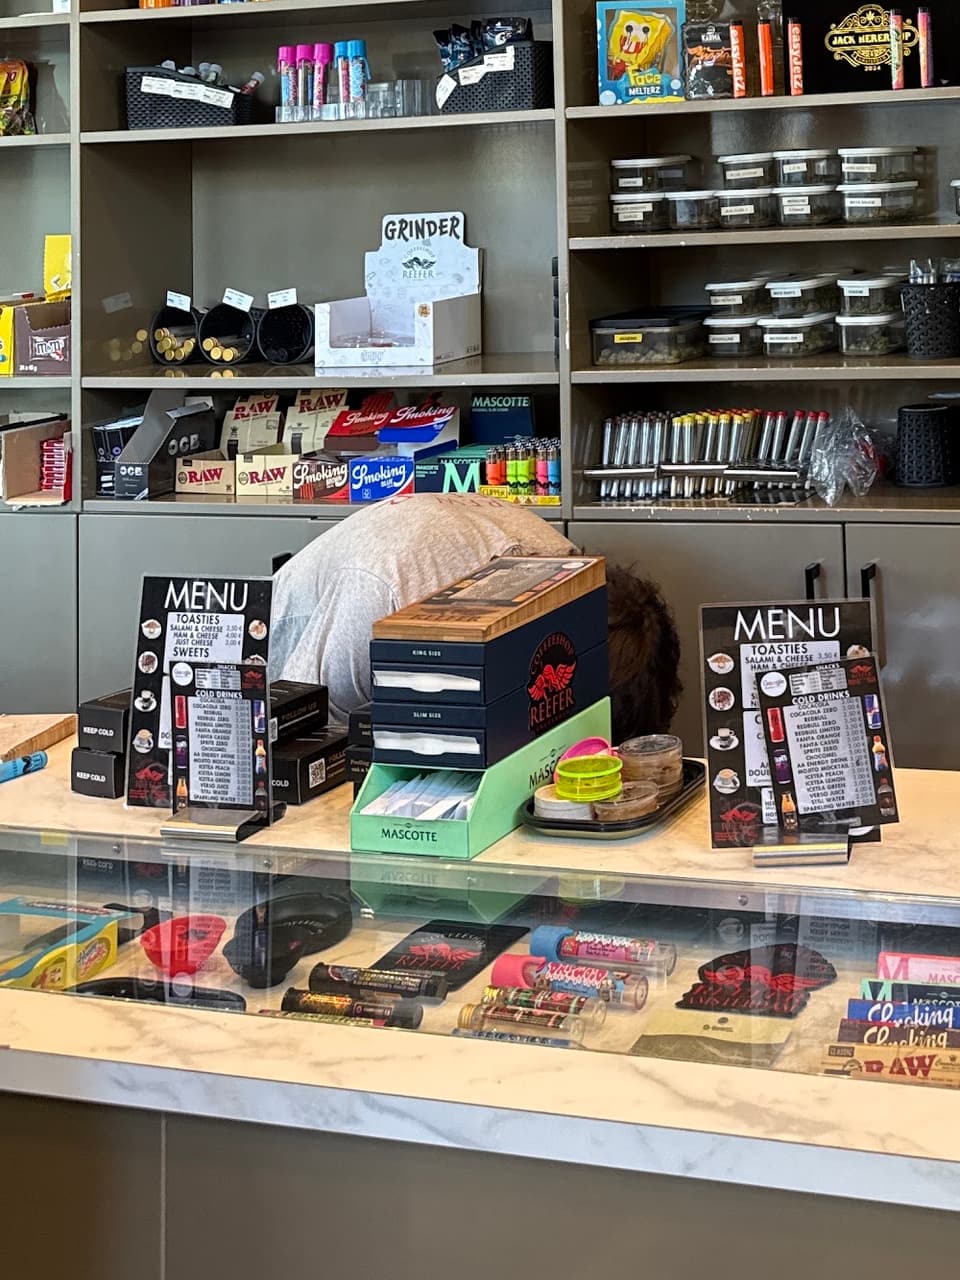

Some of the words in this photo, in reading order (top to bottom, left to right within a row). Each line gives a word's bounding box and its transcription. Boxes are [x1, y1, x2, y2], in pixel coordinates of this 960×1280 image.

[832, 35, 856, 44] JACK
[859, 34, 890, 44] HERER
[628, 68, 661, 87] Face
[629, 86, 661, 96] MELTERZ
[384, 215, 461, 242] GRINDER
[402, 268, 434, 280] REEFER
[234, 399, 275, 420] RAW
[299, 392, 344, 413] RAW
[472, 396, 529, 408] MASCOTTE
[343, 410, 389, 427] Smoking
[390, 406, 456, 423] Smoking
[188, 468, 223, 484] RAW
[249, 467, 287, 484] RAW
[293, 463, 348, 487] Smoking
[352, 464, 406, 489] Smoking
[165, 580, 248, 611] MENU
[176, 614, 220, 625] TOASTIES
[734, 607, 840, 640] MENU
[173, 647, 209, 657] SWEETS
[752, 643, 808, 655] TOASTIES
[196, 689, 215, 697] COLD
[217, 690, 242, 698] DRINKS
[792, 696, 815, 705] COLD
[818, 691, 850, 700] DRINKS
[529, 689, 577, 727] REEFER
[381, 828, 438, 842] MASCOTTE
